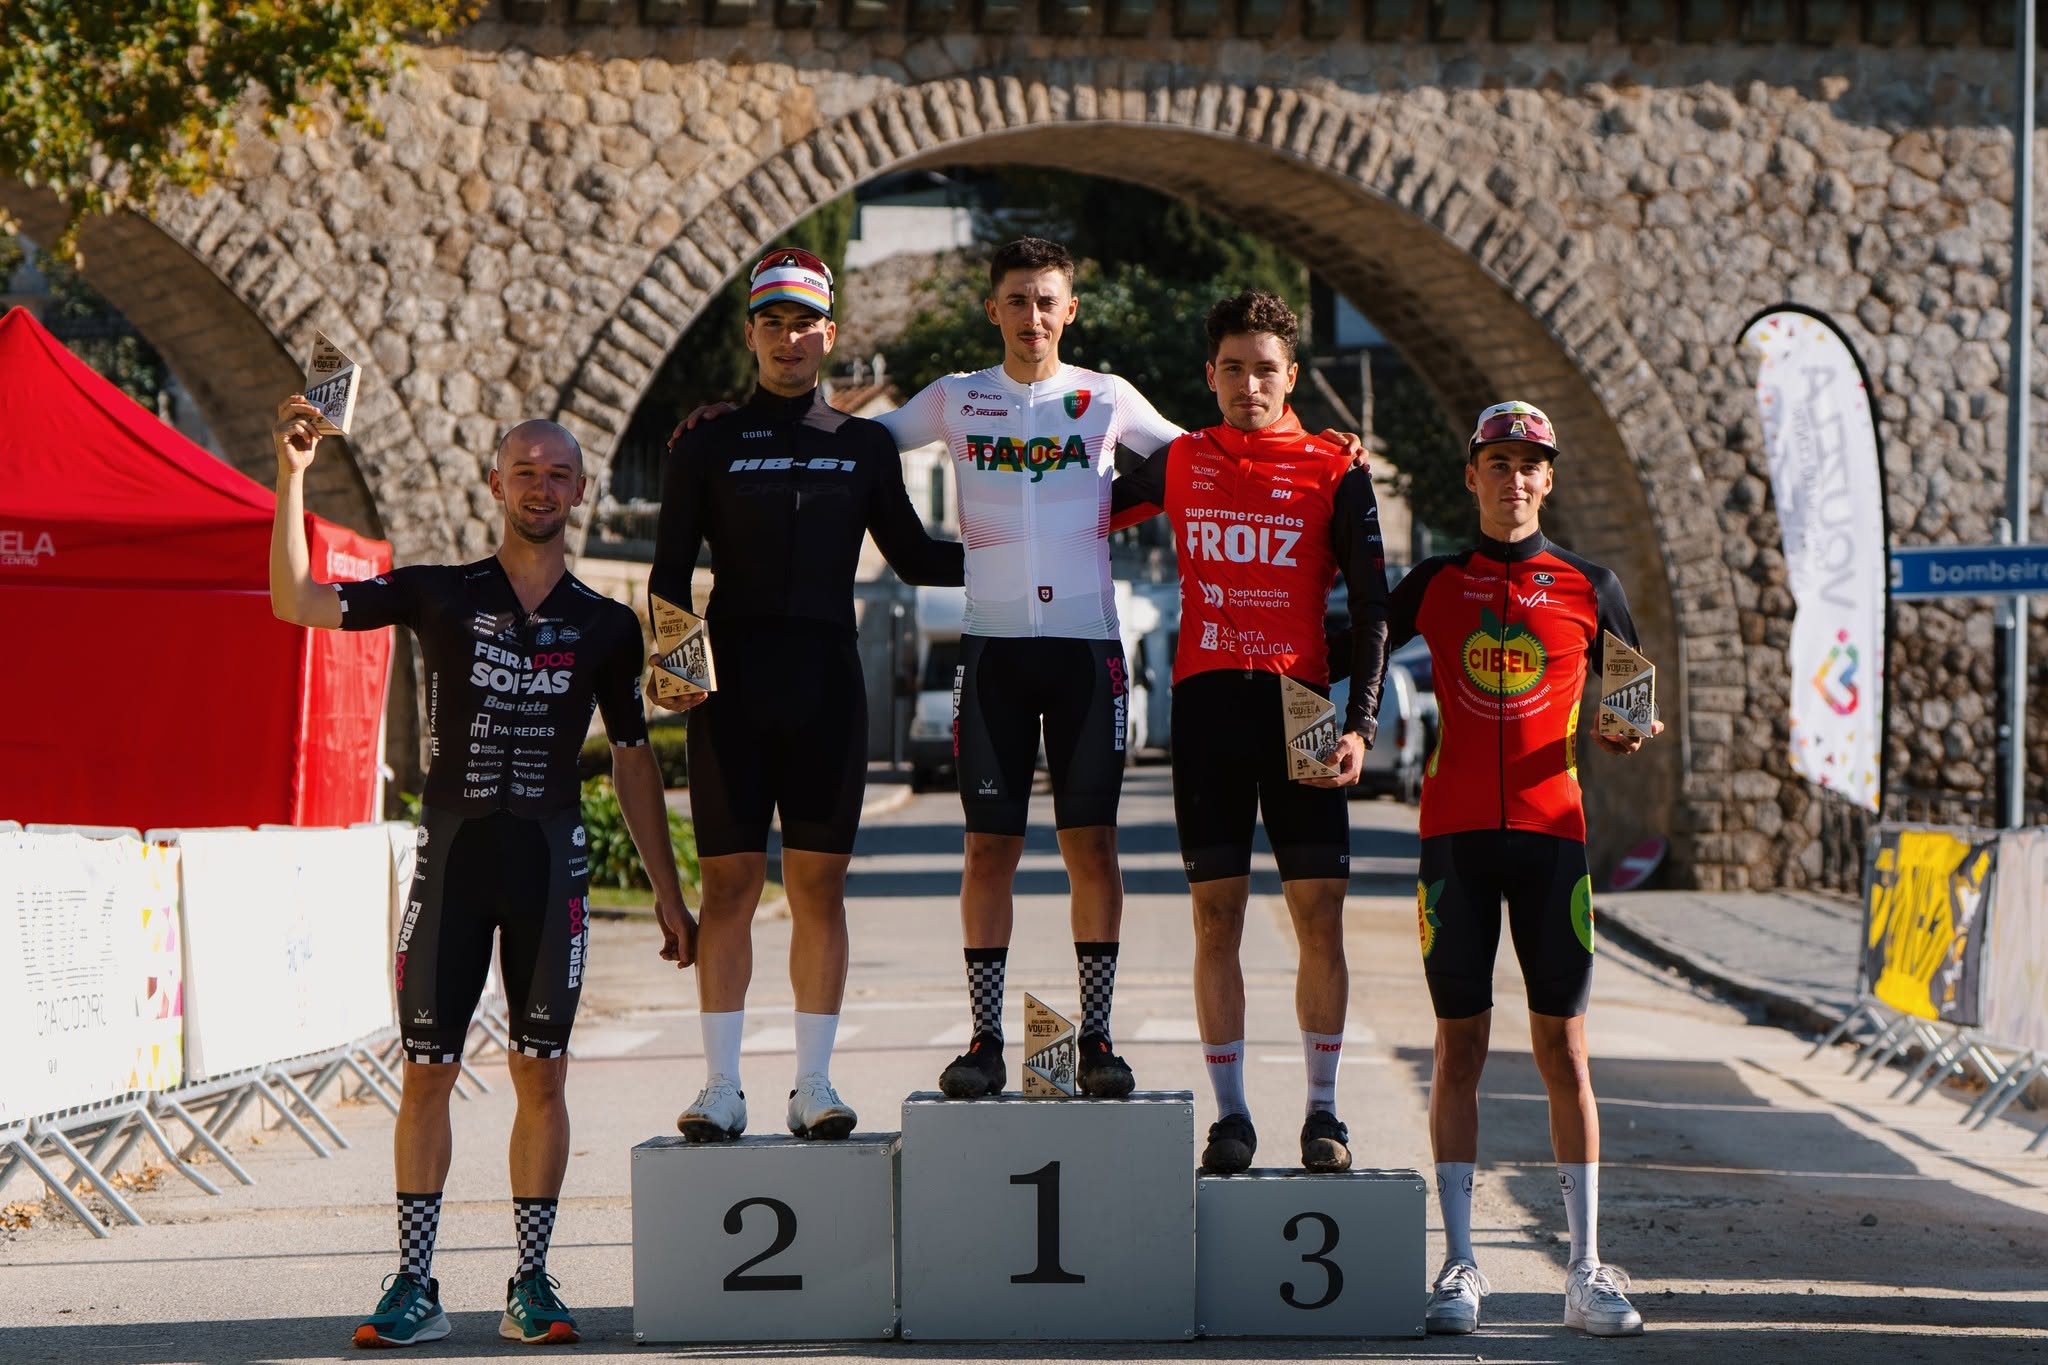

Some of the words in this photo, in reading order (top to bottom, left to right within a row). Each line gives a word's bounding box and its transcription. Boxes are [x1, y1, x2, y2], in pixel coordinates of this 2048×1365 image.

[742, 430, 773, 439] GOBIK
[728, 457, 856, 472] HB-61
[966, 434, 1090, 483] TAÇA
[1271, 489, 1293, 499] BH
[1185, 507, 1304, 528] supermercados
[1186, 521, 1303, 567] FROIZ
[1228, 588, 1289, 600] Deputación
[1229, 598, 1290, 608] Pontevedra
[474, 641, 533, 670] FEIRA
[533, 652, 576, 669] DOS
[1220, 640, 1237, 652] DE
[1243, 643, 1294, 655] GALICIA
[1469, 648, 1537, 673] CIBEL
[469, 662, 573, 695] SOFÁS
[952, 665, 965, 720] FEIRA
[483, 695, 549, 712] Boavista
[493, 725, 555, 737] PAREDES
[1113, 694, 1125, 751] FEIRA
[398, 901, 422, 953] FEIRA
[569, 897, 583, 934] DOS
[568, 933, 582, 989] FEIRA
[1206, 1053, 1237, 1064] FROIZ
[1009, 1160, 1085, 1284] 1
[722, 1196, 803, 1291] 2
[1278, 1210, 1344, 1310] 3
